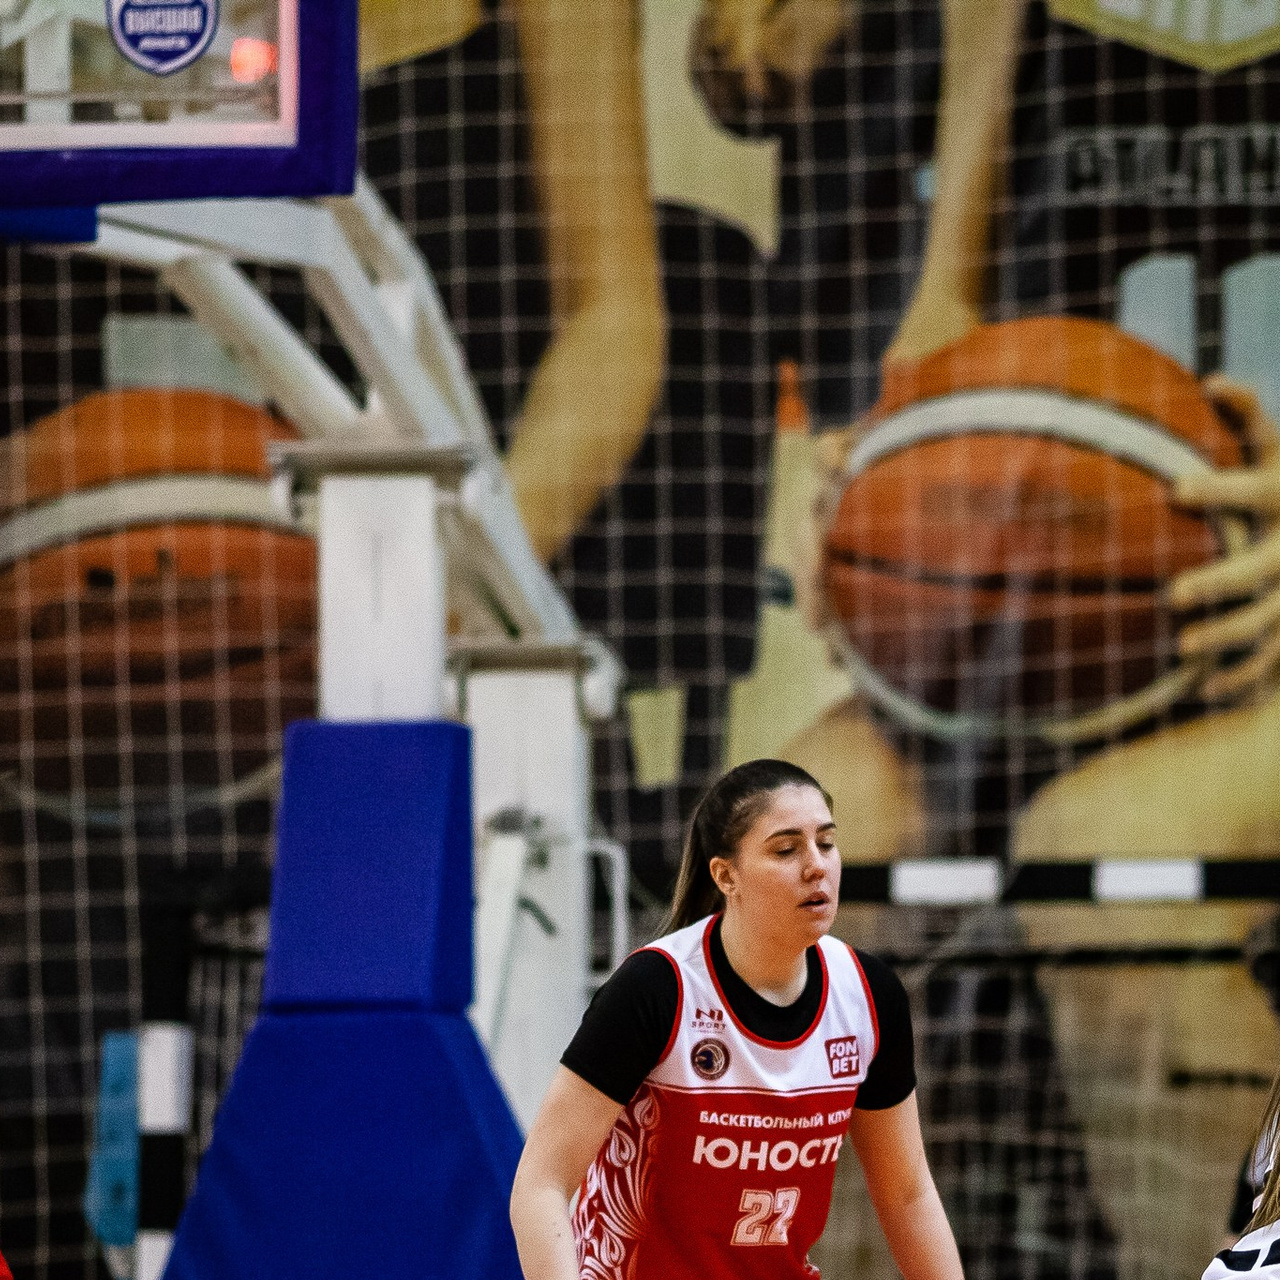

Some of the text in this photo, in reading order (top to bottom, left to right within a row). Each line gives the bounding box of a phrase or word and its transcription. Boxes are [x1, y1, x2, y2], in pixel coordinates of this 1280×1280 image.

[829, 1040, 858, 1058] FON
[831, 1055, 860, 1075] BET
[699, 1110, 824, 1129] БАСКЕТБОЛЬНЫЙ
